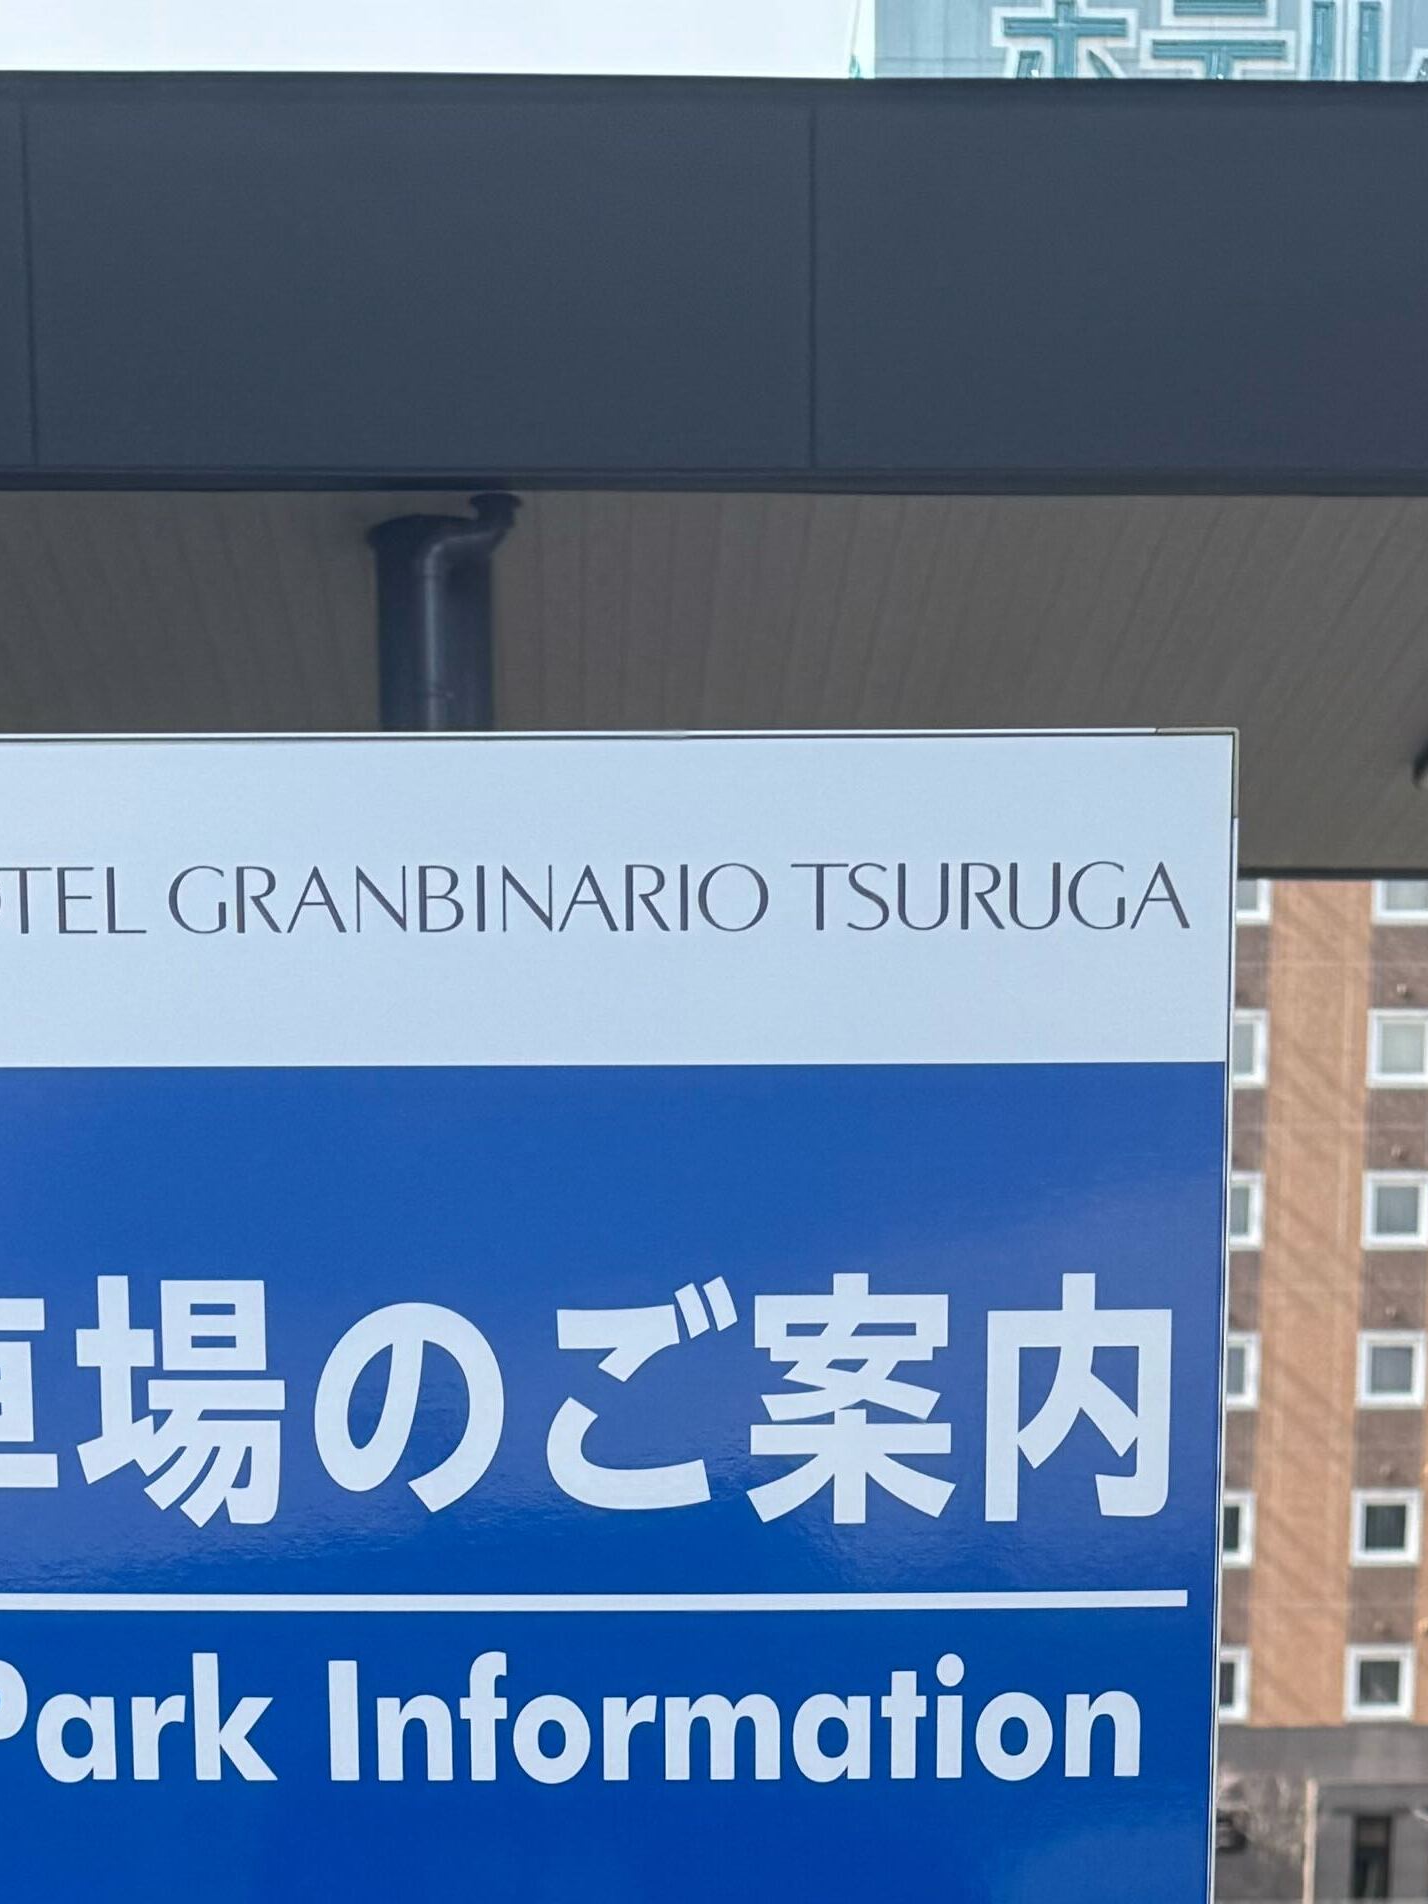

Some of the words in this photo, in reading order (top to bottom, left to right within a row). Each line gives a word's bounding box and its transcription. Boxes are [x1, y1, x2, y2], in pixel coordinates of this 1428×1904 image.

[168, 862, 770, 934] GRANBINARIO
[790, 861, 1191, 931] TSURUGA
[328, 1650, 1142, 1785] Information
